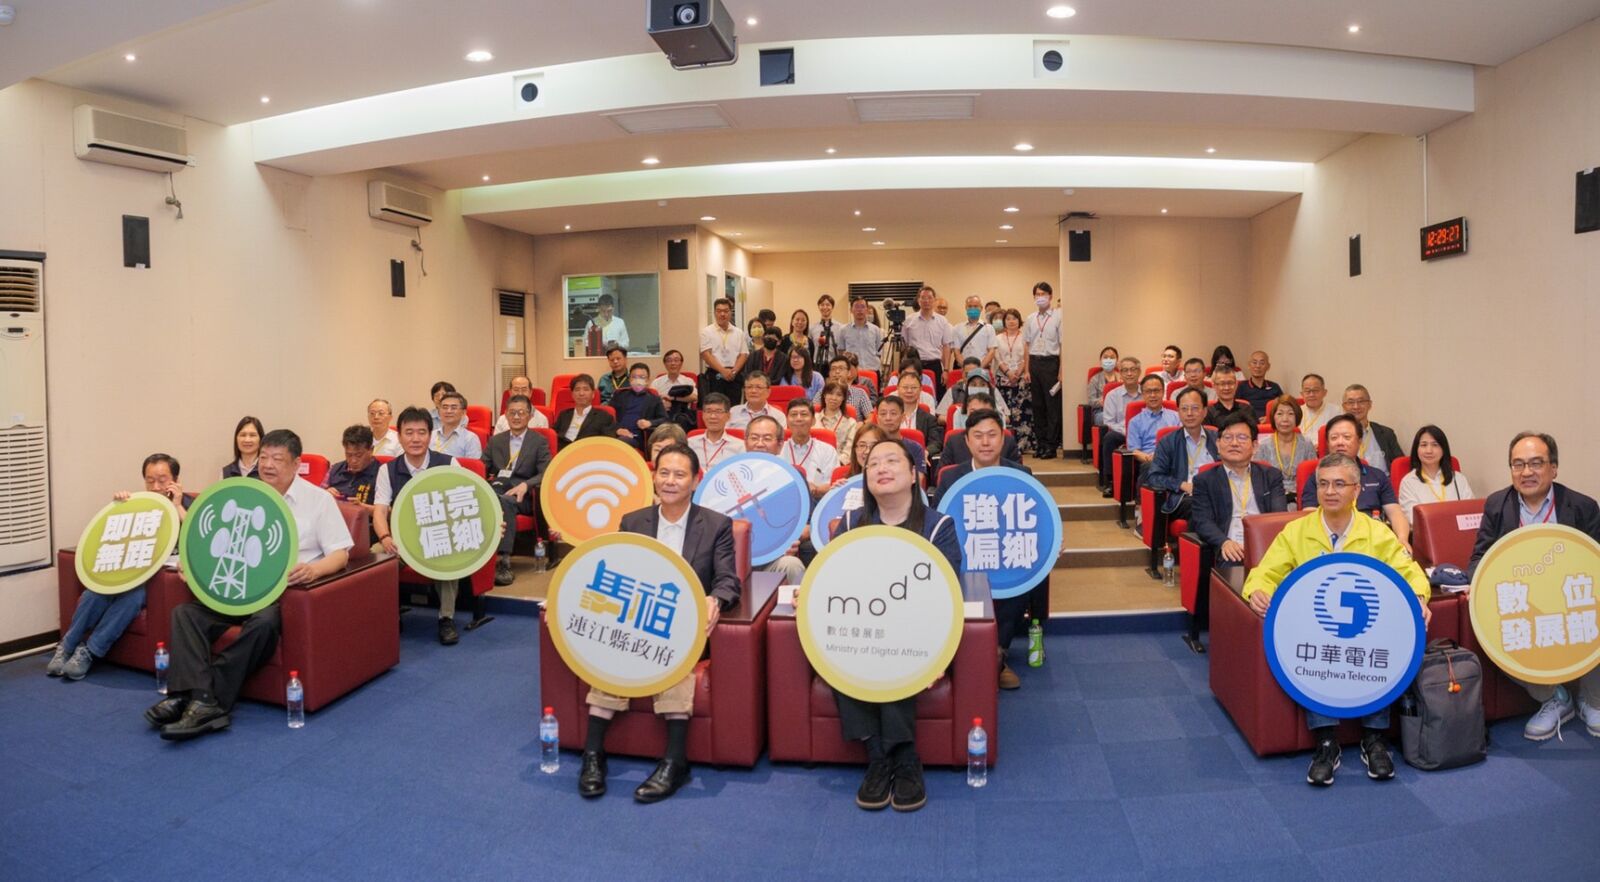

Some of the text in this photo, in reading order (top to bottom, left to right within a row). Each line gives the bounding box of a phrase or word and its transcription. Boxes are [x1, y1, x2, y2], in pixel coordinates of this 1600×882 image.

[412, 485, 480, 526] 點亮
[962, 493, 1037, 531] 強化
[100, 509, 164, 542] 即時
[419, 517, 485, 559] 偏鄉
[92, 538, 157, 573] 無距
[963, 532, 1038, 571] 偏鄉
[1512, 542, 1565, 577] moda
[582, 559, 681, 640] 馬祖
[827, 562, 931, 617] moda
[566, 613, 675, 667] 連江縣政府
[1501, 609, 1599, 652] 發展部
[825, 643, 929, 658] Ministry of Digital Affairs
[1296, 642, 1390, 669] 中華電信
[1295, 665, 1387, 683] Chunghwa Telecom
